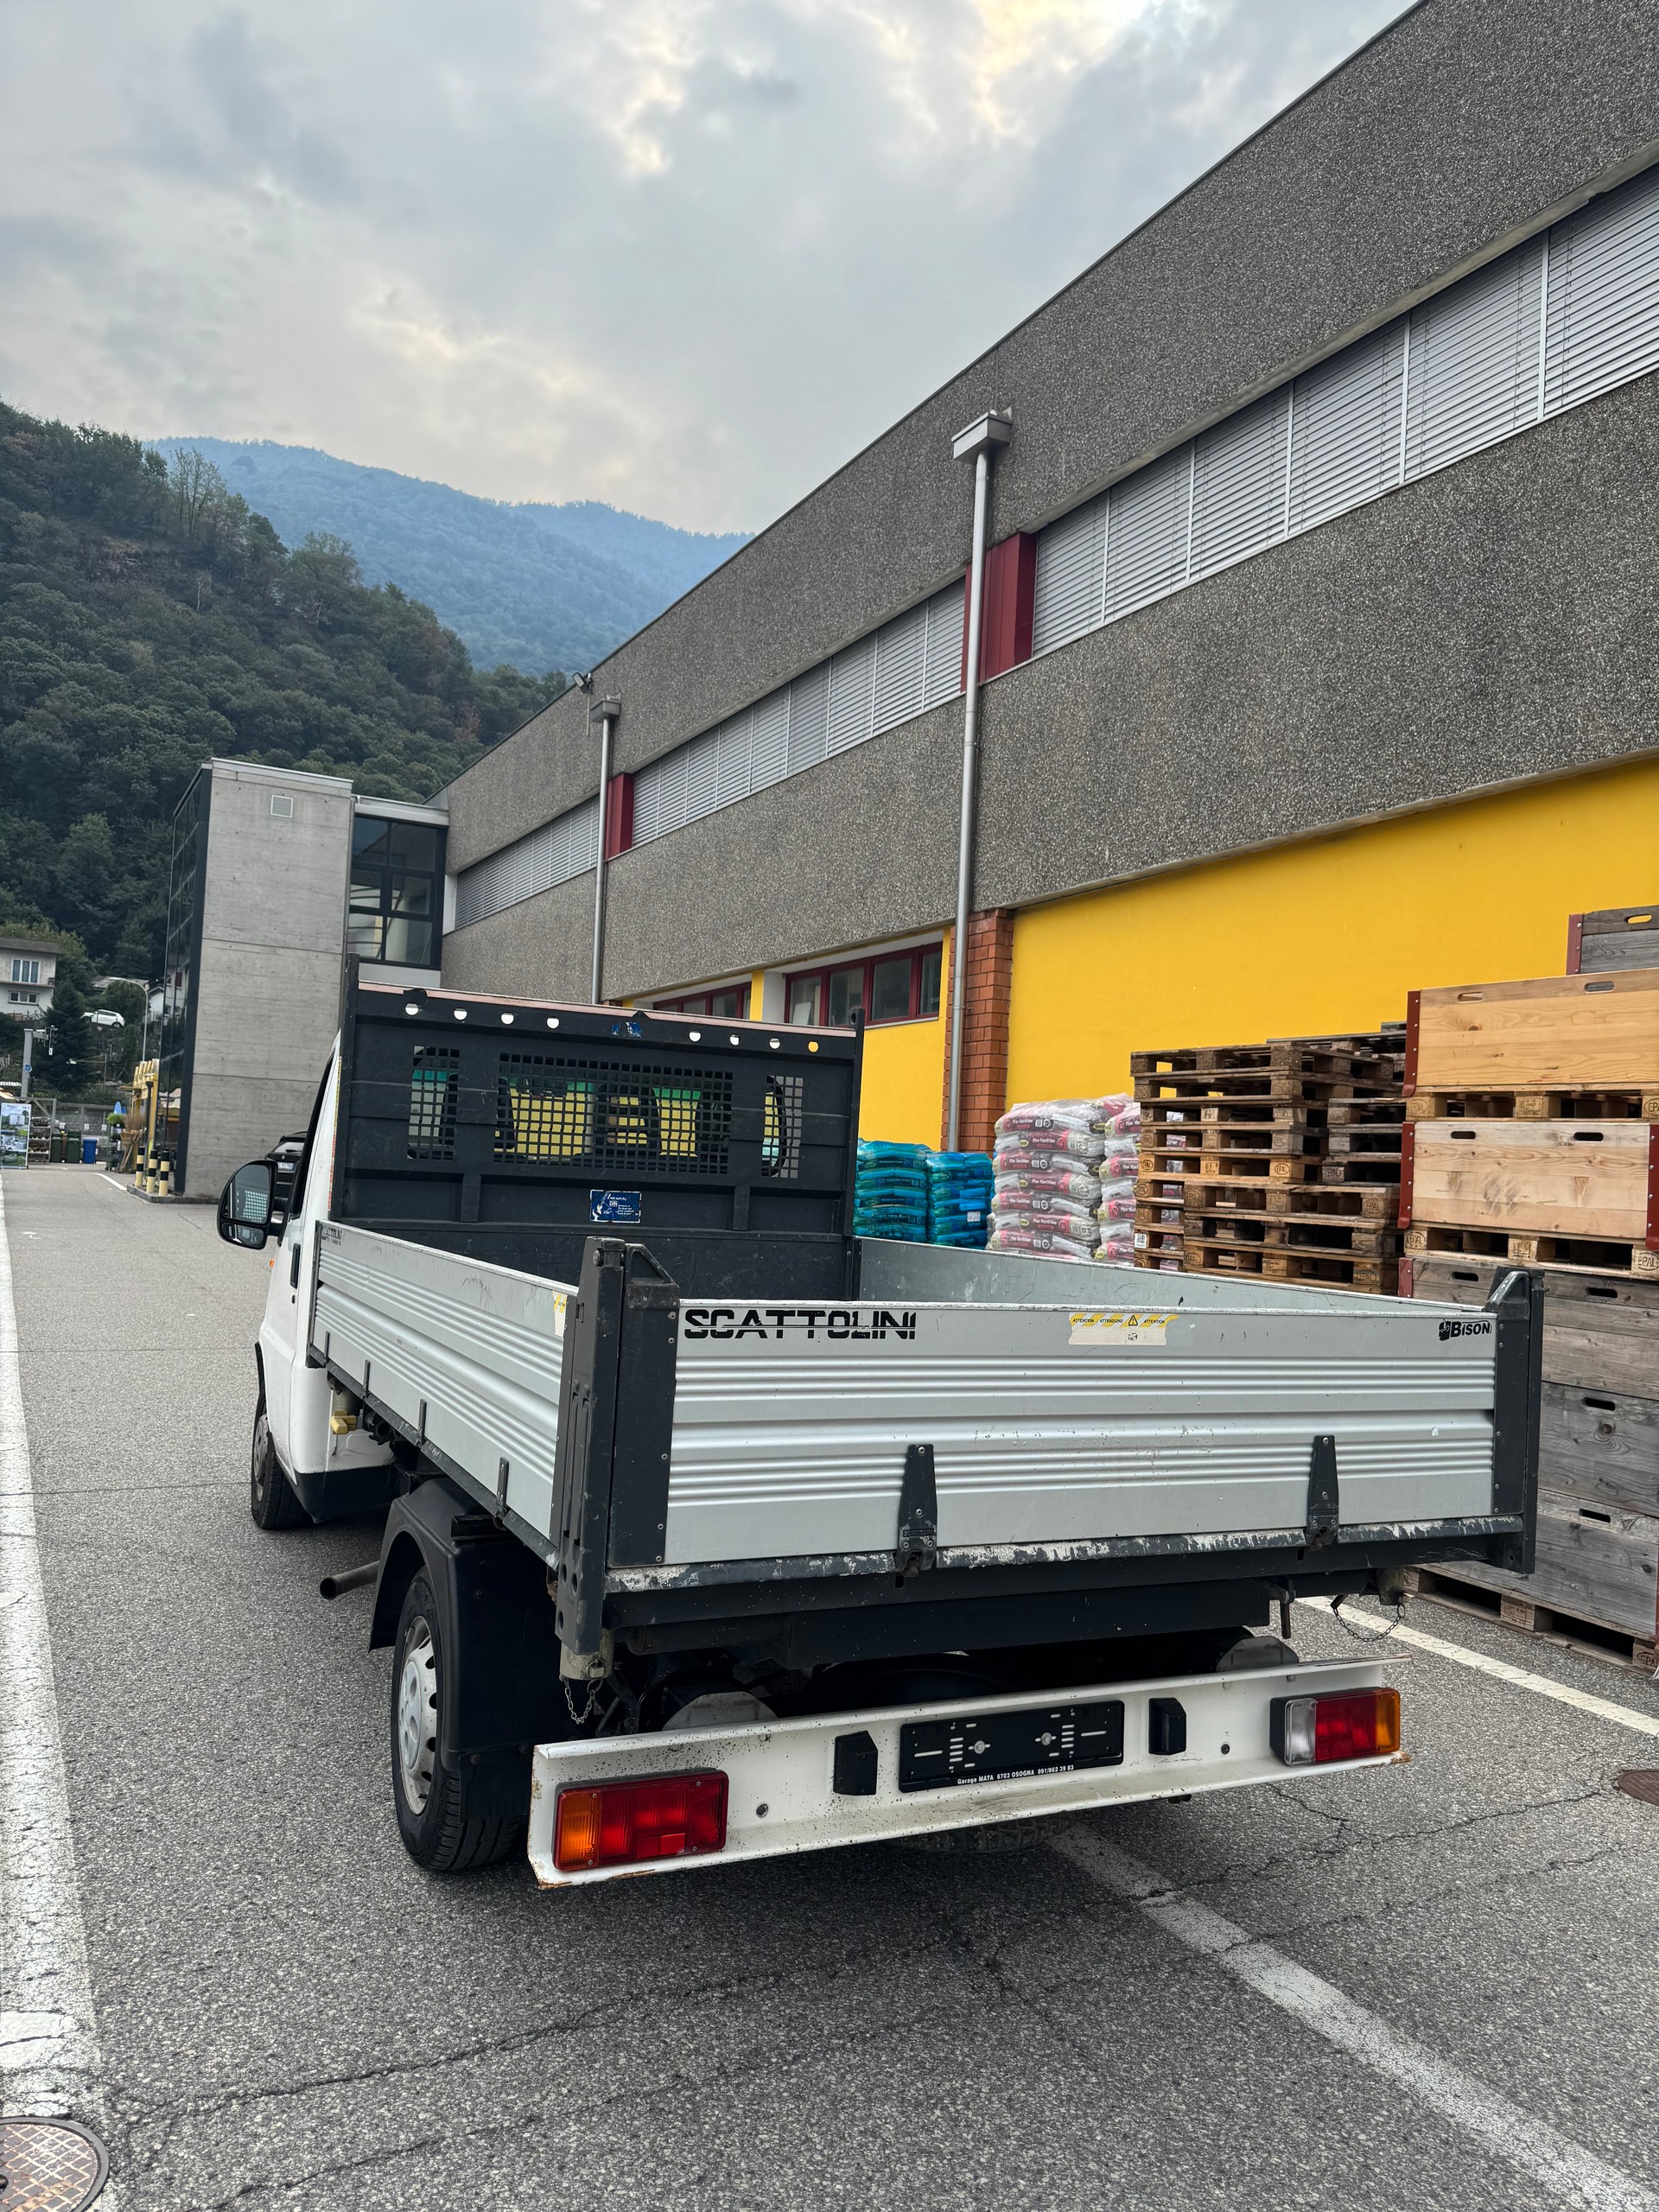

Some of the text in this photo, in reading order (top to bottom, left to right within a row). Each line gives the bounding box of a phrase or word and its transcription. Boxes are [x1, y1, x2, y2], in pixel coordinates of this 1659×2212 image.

[1638, 1255, 1656, 1268] EPAL
[684, 1308, 916, 1340] SCATTOLINI
[1011, 1769, 1035, 1778] OSOGNA
